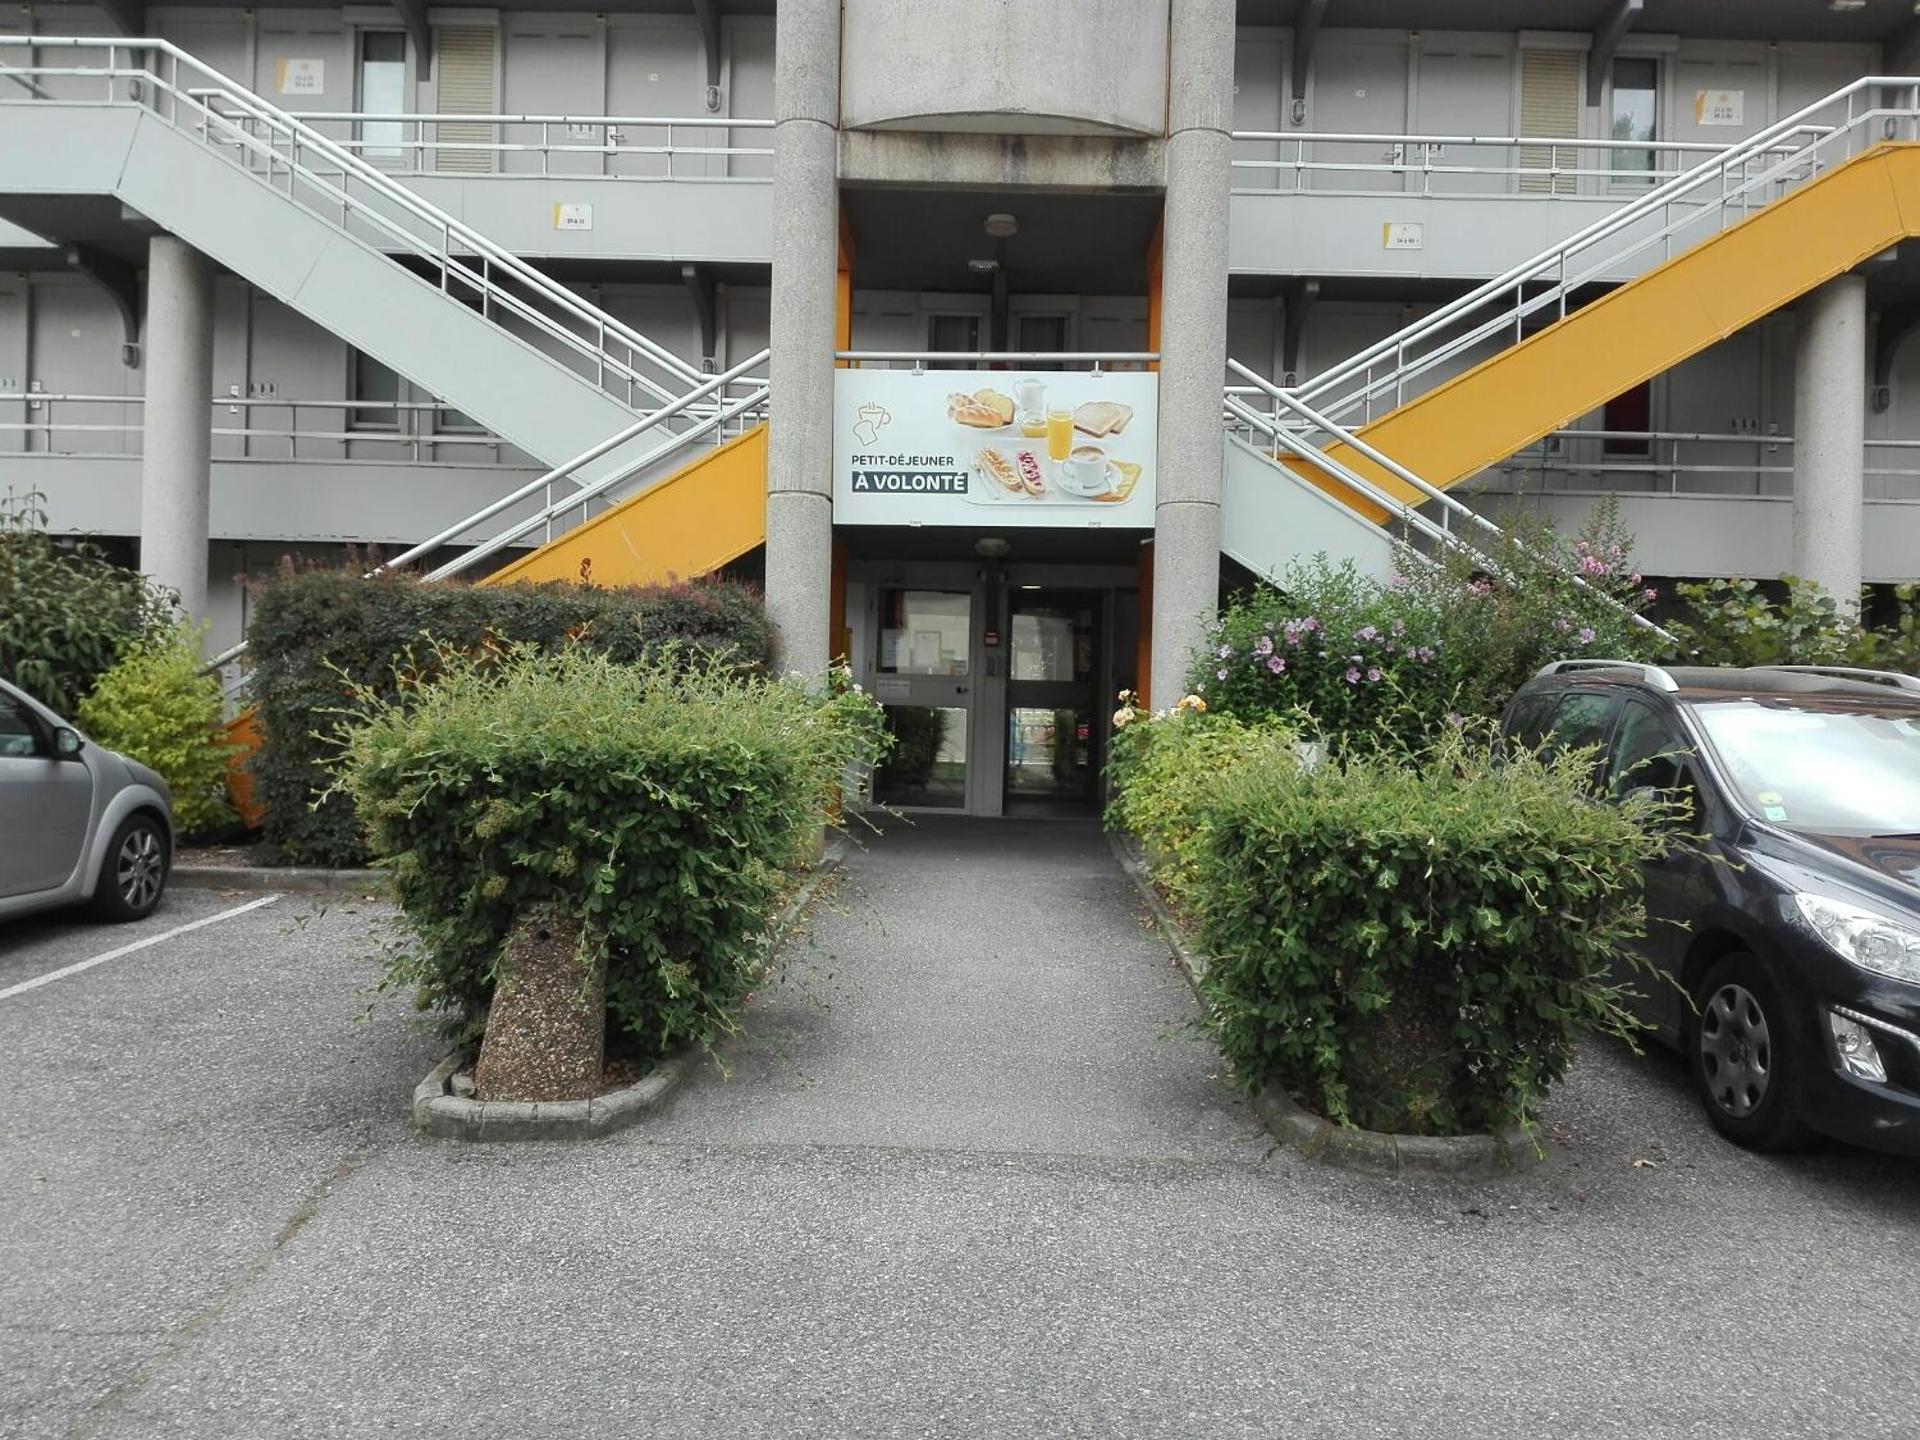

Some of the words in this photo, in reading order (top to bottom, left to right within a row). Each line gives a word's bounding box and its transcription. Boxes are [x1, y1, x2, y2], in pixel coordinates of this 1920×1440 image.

[852, 453, 954, 466] PETIT-DÉJEUNER
[855, 471, 869, 490] À
[873, 472, 965, 491] VOLONTÉ
